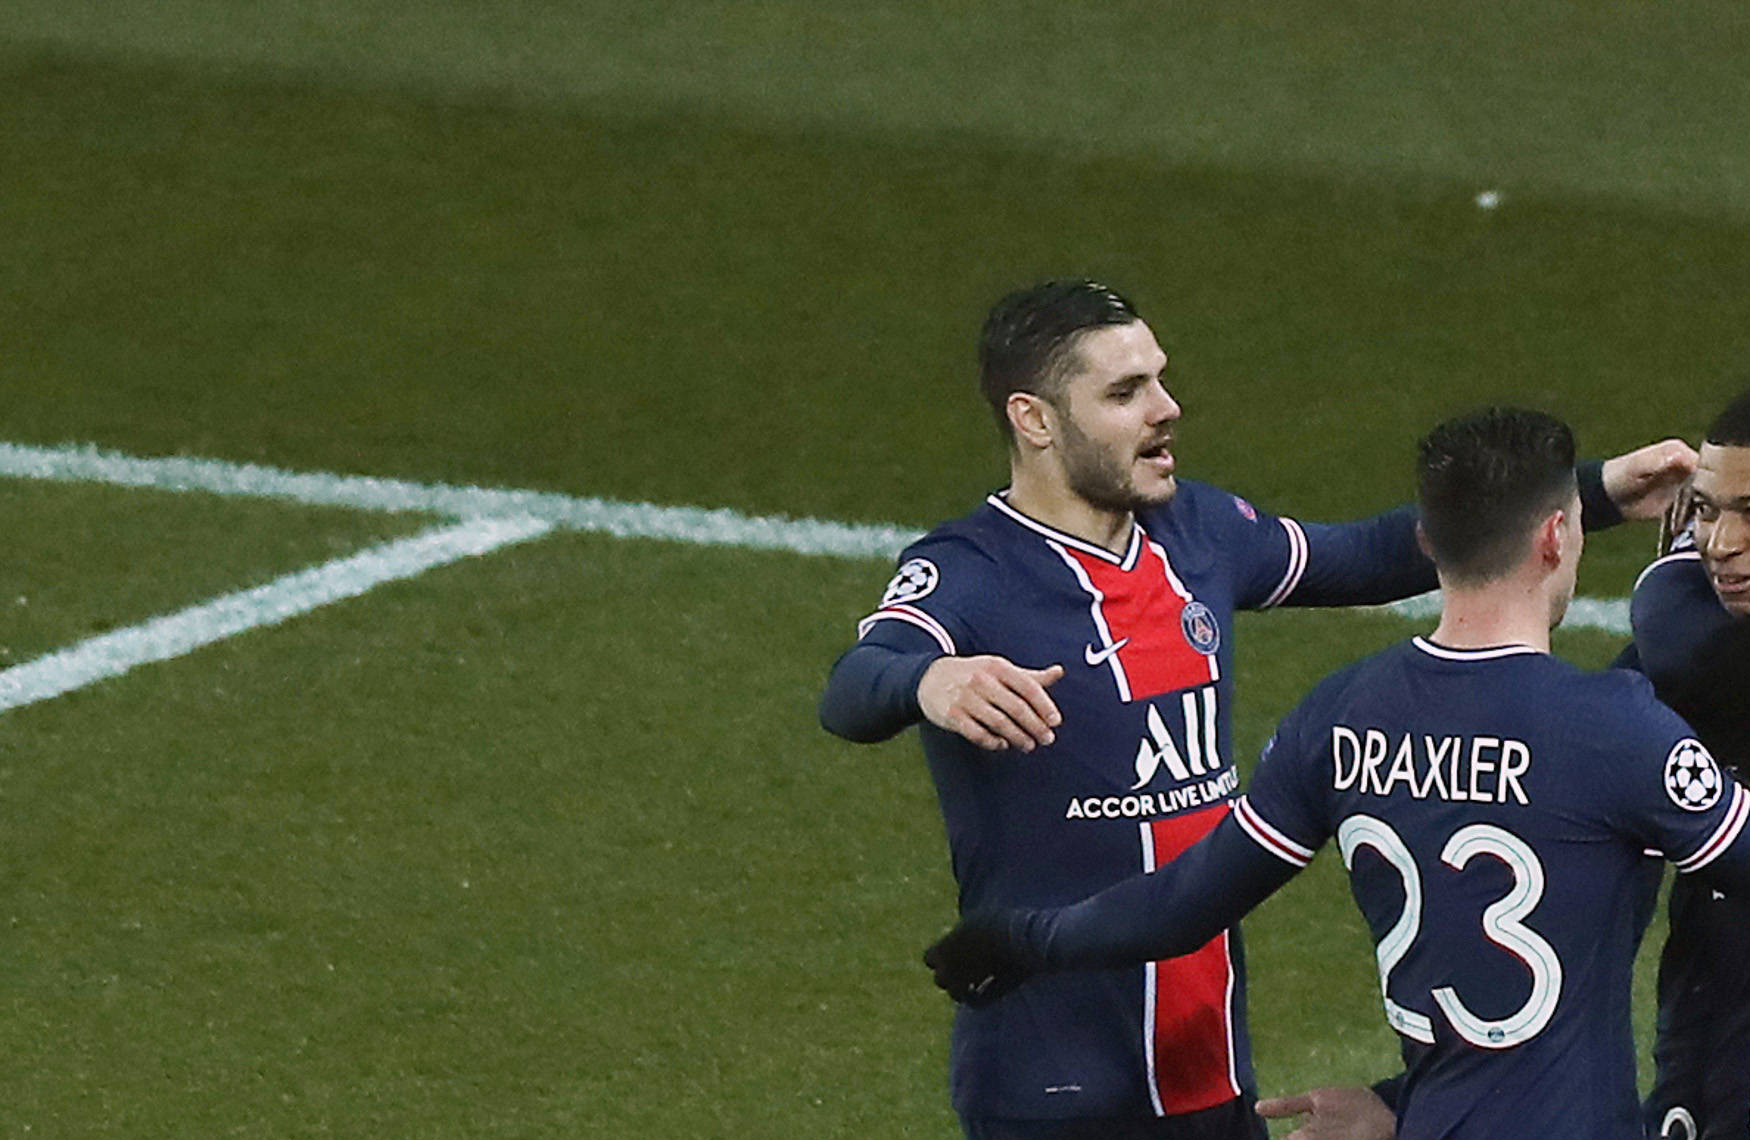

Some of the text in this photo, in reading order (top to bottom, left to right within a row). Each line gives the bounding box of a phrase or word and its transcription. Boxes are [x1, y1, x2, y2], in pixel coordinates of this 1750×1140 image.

[1065, 794, 1157, 819] ACCOR
[1157, 784, 1199, 813] LIVE
[1332, 726, 1531, 805] DRAXLER
[1337, 813, 1563, 1050] 23
